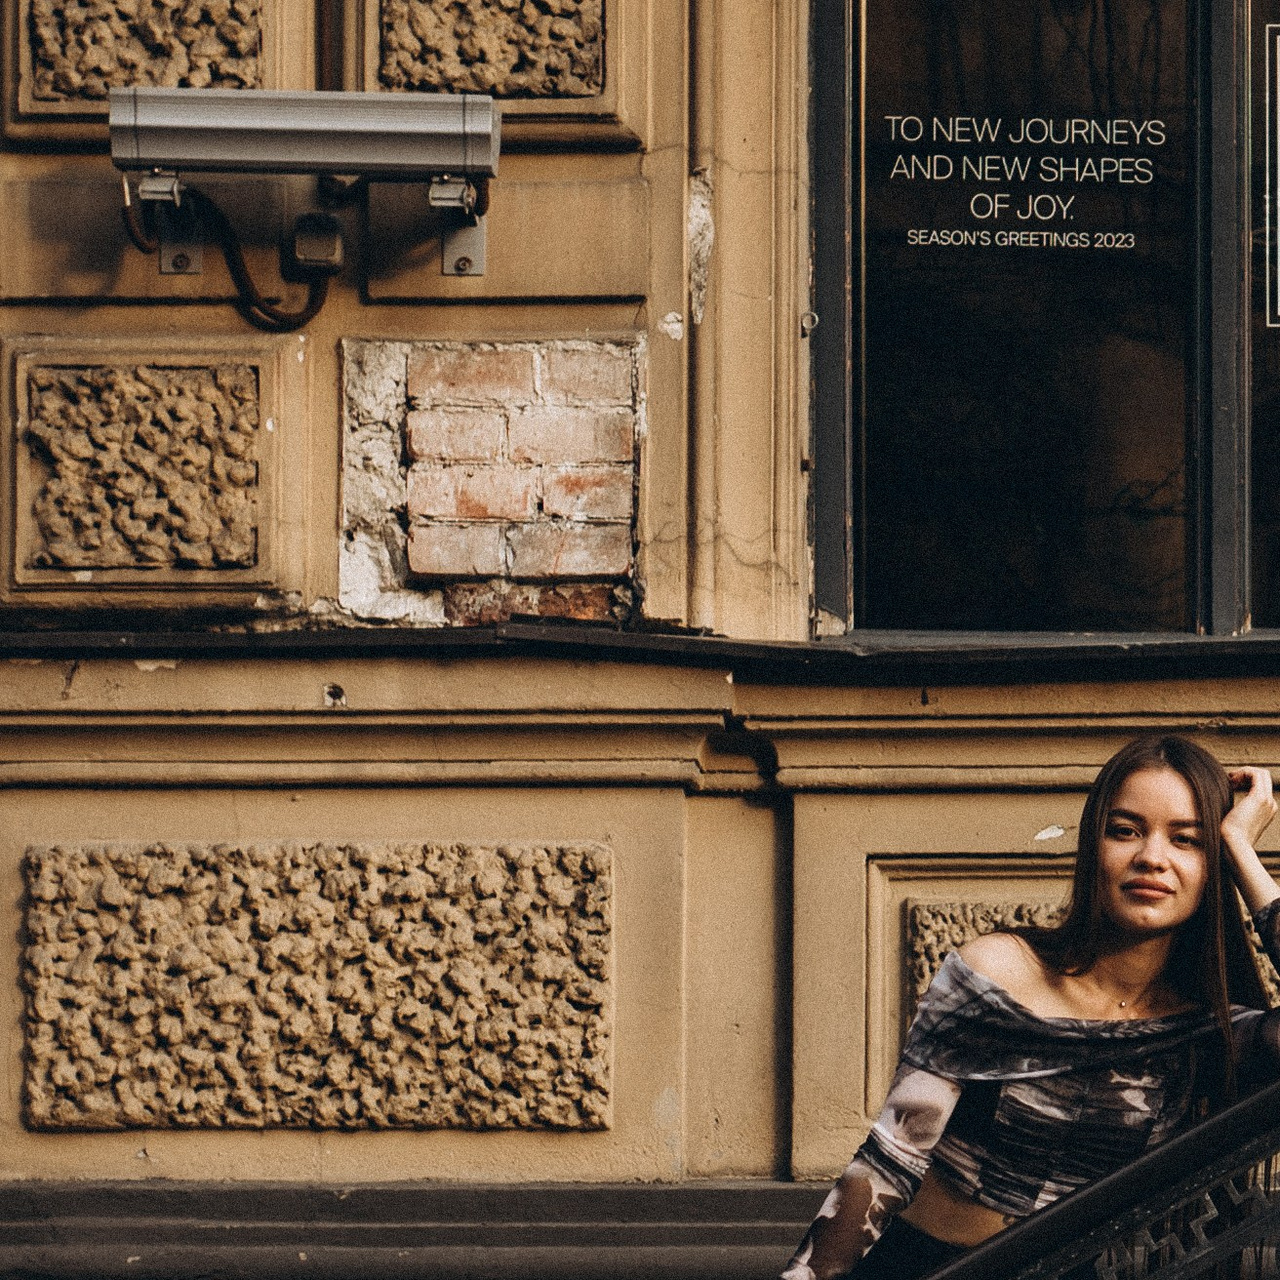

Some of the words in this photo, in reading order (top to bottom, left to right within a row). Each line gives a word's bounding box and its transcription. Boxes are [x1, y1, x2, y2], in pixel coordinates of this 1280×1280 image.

[884, 115, 923, 142] TO
[932, 116, 1002, 143] NEW
[1008, 117, 1166, 146] JOURNEYS
[890, 154, 954, 181] AND
[962, 155, 1032, 182] NEW
[1039, 156, 1154, 184] SHAPES
[969, 192, 1011, 219] OF
[1016, 194, 1075, 221] JOY.
[907, 228, 992, 246] SEASON'S
[994, 230, 1091, 248] GREETINGS
[1093, 233, 1136, 249] 2023
